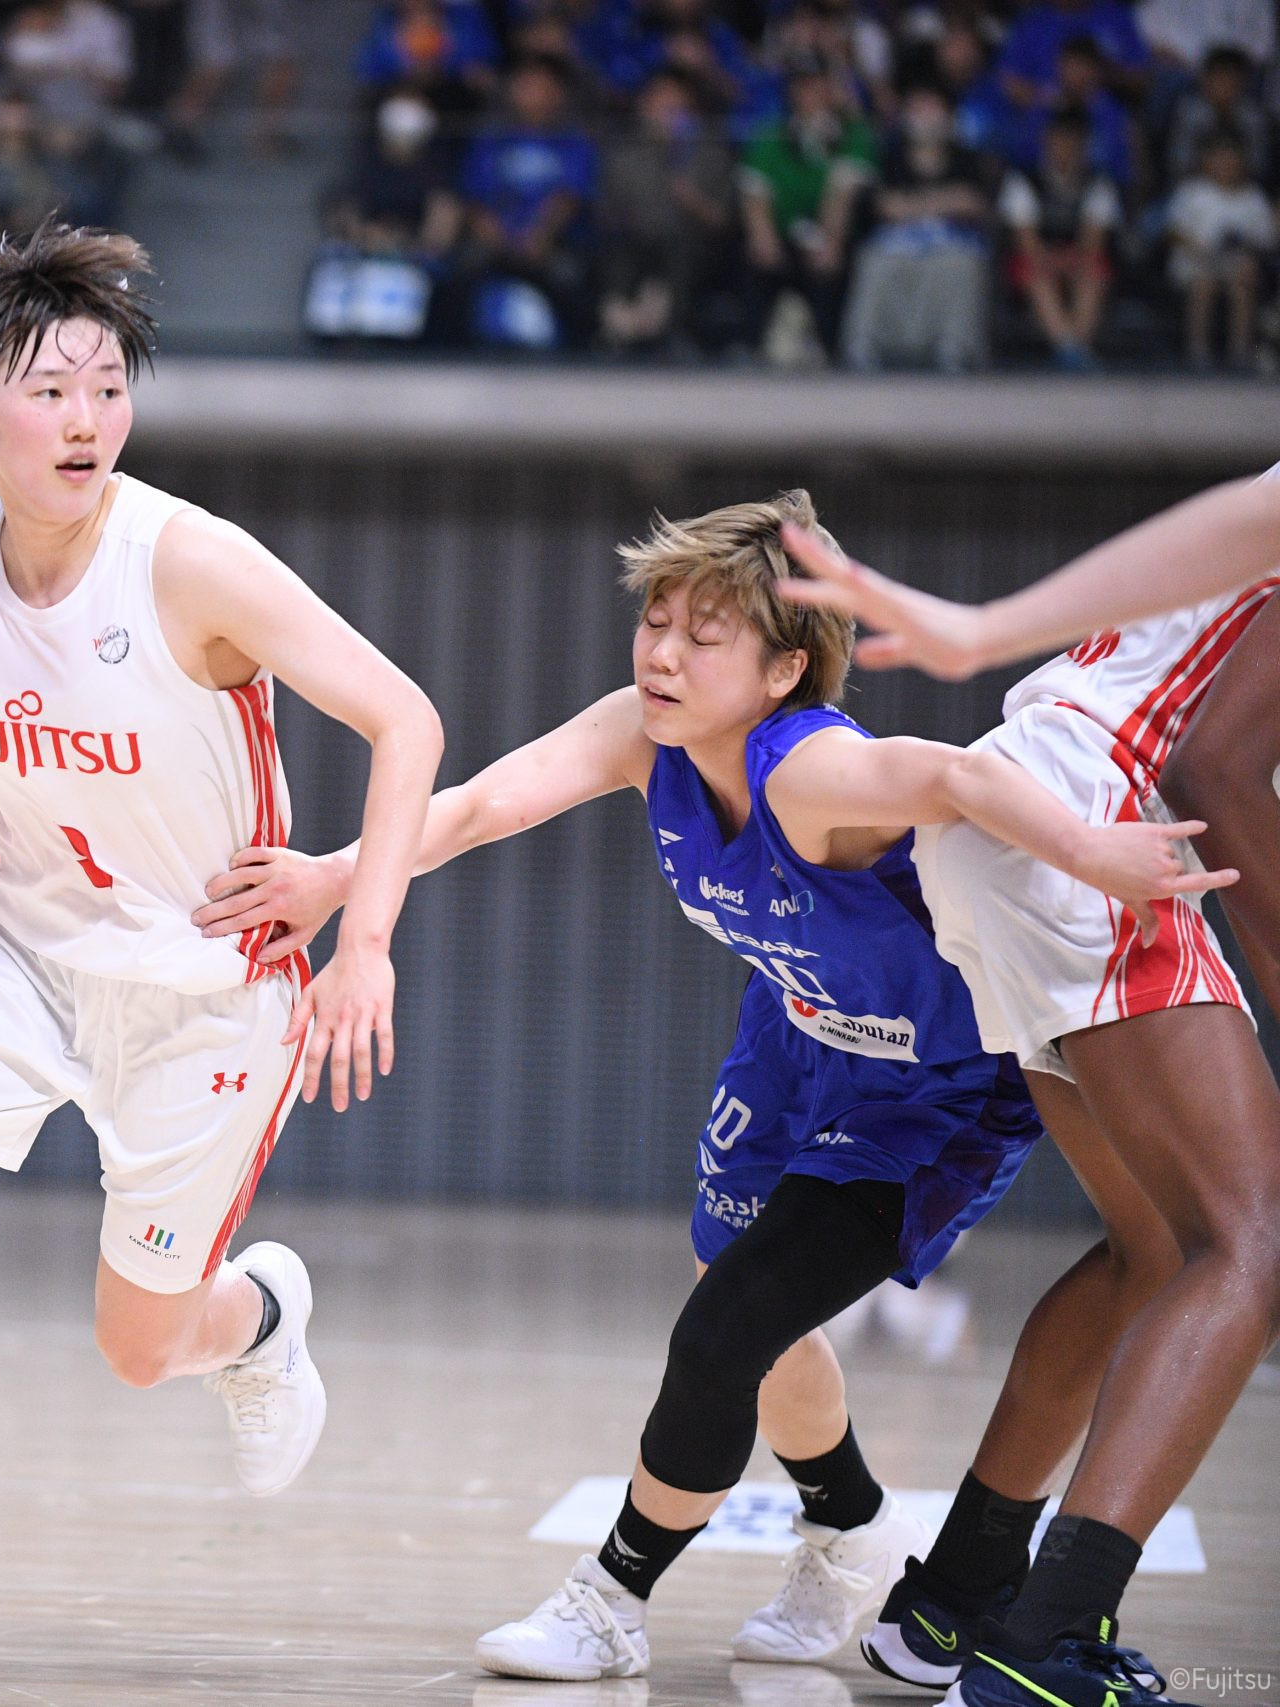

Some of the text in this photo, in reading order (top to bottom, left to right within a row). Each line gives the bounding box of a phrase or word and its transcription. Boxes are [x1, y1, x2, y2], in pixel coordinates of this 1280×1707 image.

[699, 876, 745, 905] Vickies
[826, 1026, 862, 1044] MINKABU
[128, 1235, 162, 1257] KAWASAKI
